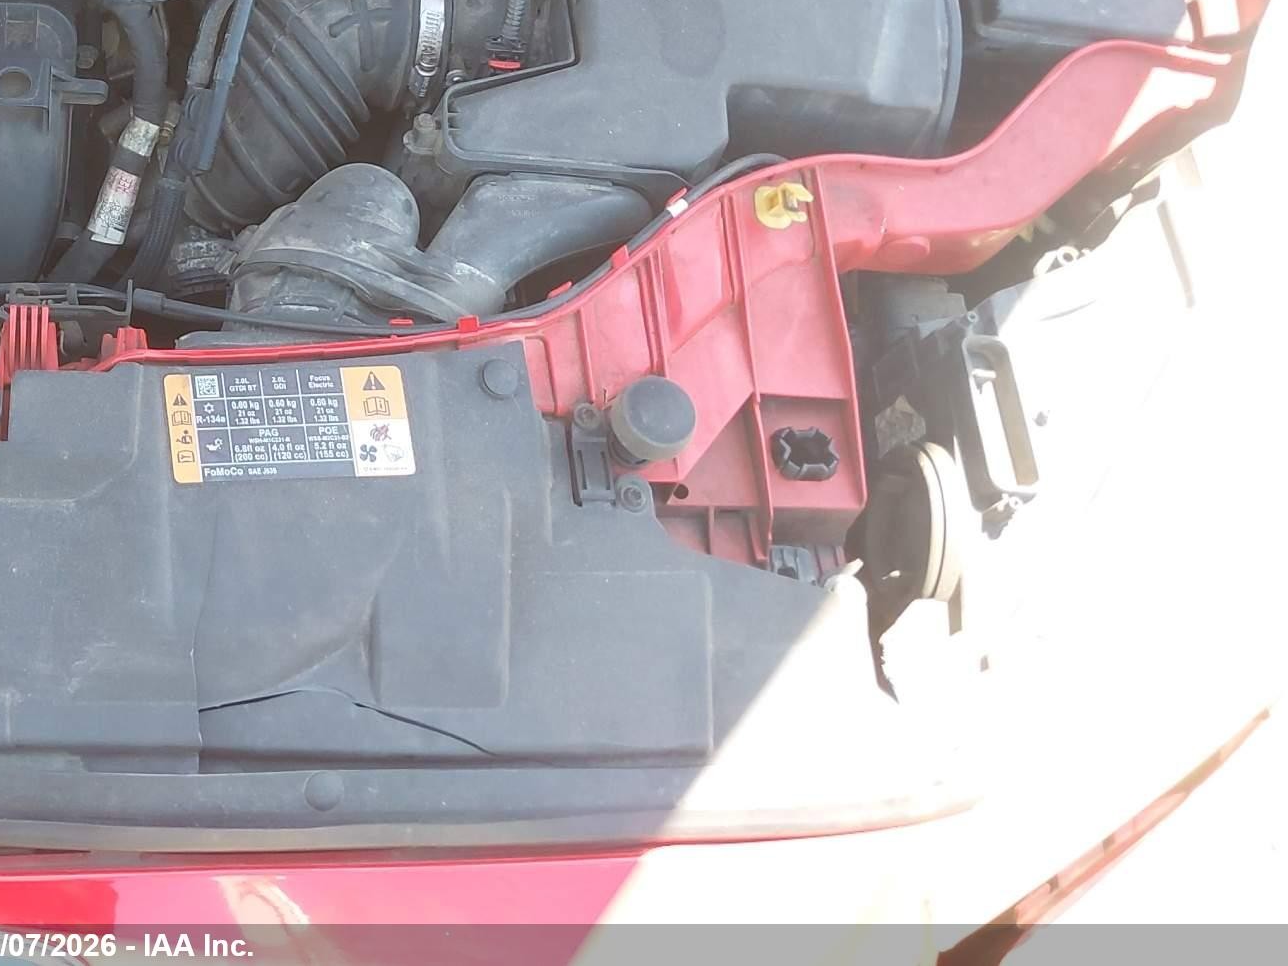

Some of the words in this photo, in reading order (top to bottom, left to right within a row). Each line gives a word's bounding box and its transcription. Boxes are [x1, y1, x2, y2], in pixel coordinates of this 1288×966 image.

[307, 381, 334, 389] Electric
[231, 400, 248, 410] 0.60
[249, 400, 260, 411] kg
[268, 398, 285, 408] 0.60
[286, 398, 297, 408] kg
[309, 397, 327, 407] 0.60
[327, 397, 338, 408] kg
[274, 408, 283, 416] 21
[195, 414, 226, 425] R-134a
[235, 418, 249, 426] 1.32
[249, 417, 261, 425] lbs
[286, 415, 298, 423] lbs
[258, 428, 280, 437] PAG
[318, 426, 339, 435] POE
[271, 443, 285, 451] 4.0
[286, 442, 292, 451] fl
[313, 442, 327, 450] 5.2
[328, 441, 335, 449] fl
[234, 453, 253, 463] (200
[254, 452, 269, 462] cc)
[273, 452, 292, 461] (120
[293, 451, 307, 461] cc)
[315, 450, 334, 460] (155
[335, 449, 350, 459] cc)
[203, 466, 244, 477] FoMoCo
